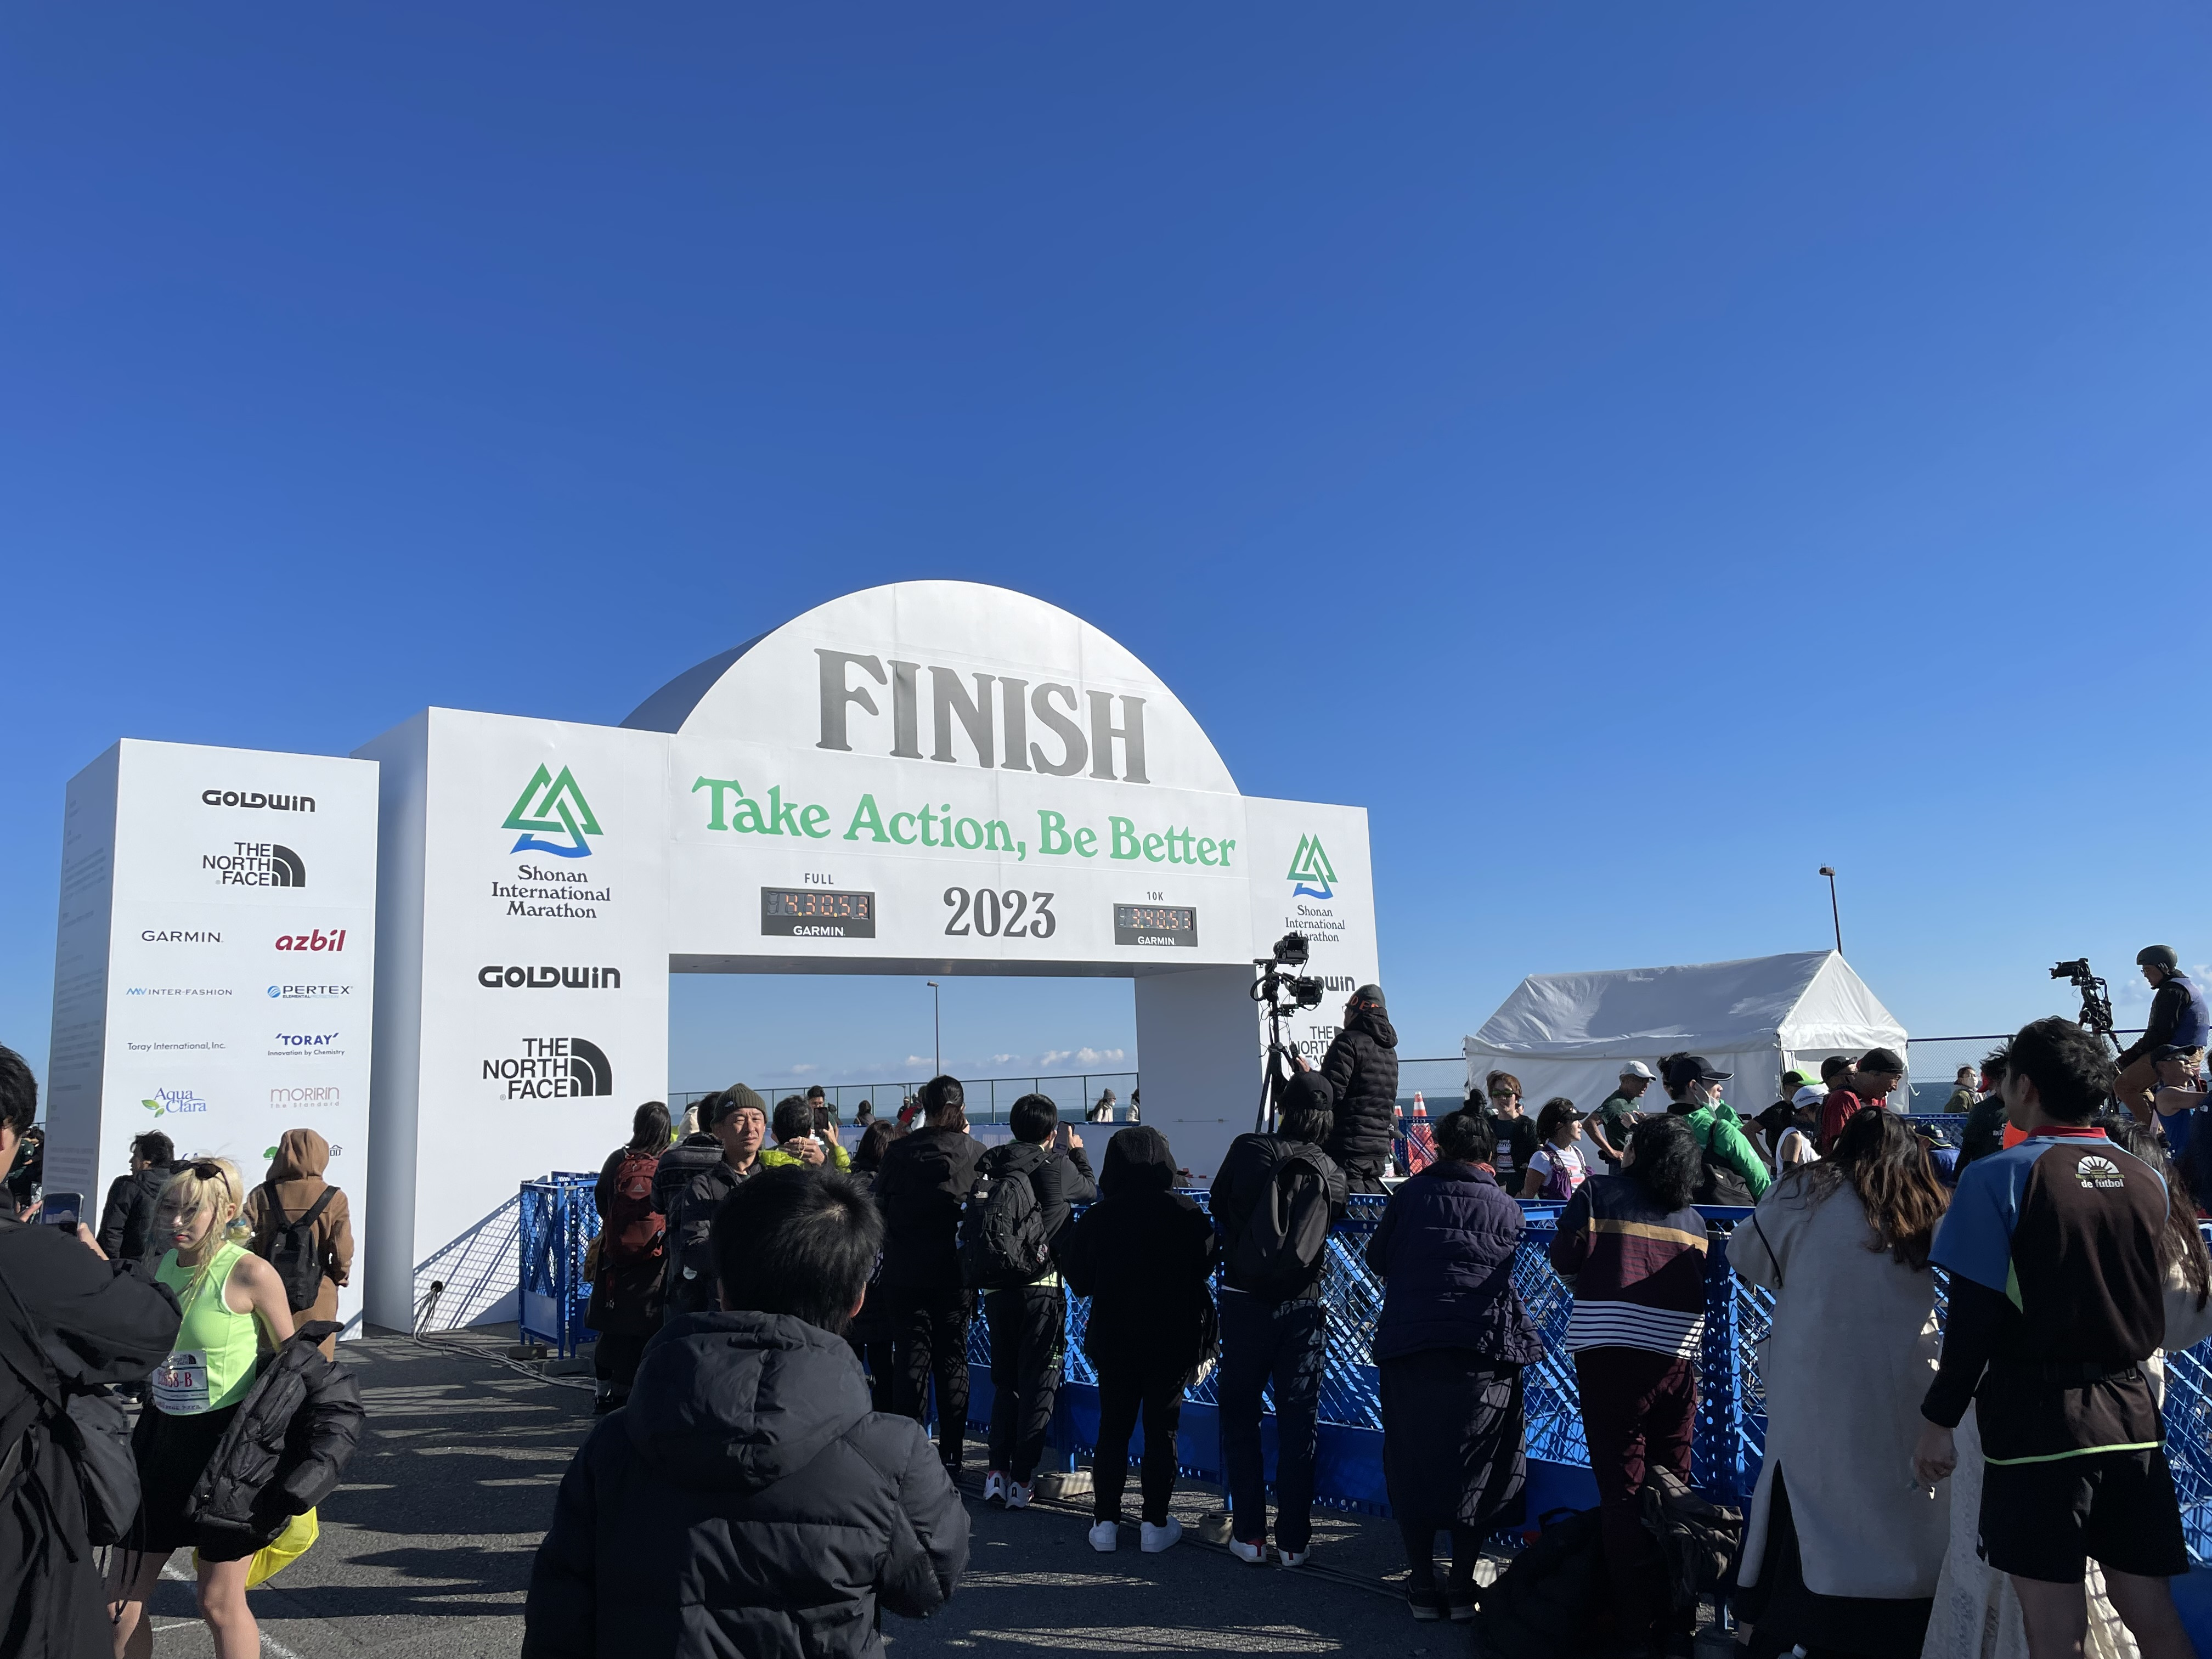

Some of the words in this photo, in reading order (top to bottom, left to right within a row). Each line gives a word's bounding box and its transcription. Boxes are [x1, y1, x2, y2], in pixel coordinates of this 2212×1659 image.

[814, 648, 1150, 784] FINISH
[692, 776, 830, 838] Take
[843, 793, 1026, 861] Action,
[1039, 809, 1098, 859] Be
[1109, 815, 1235, 867] Better
[234, 842, 271, 857] THE
[203, 855, 270, 871] NORTH
[222, 871, 270, 887] FACE
[518, 865, 589, 883] Shonan
[804, 873, 834, 884] FULL
[492, 882, 611, 901] International
[1147, 891, 1164, 901] 10K
[506, 901, 597, 918] Marathon
[944, 887, 1056, 939] 2023
[1297, 905, 1333, 917] Shonan
[793, 926, 844, 936] GARMIN
[1285, 917, 1345, 930] International
[142, 930, 221, 943] GARMIN
[275, 929, 346, 952] azbil
[1137, 936, 1175, 945] GARMIN
[283, 985, 350, 995] PERTEX
[1310, 1025, 1333, 1040] THE
[128, 1042, 152, 1052] Toray
[522, 1037, 568, 1057] THE
[1297, 1040, 1333, 1054] ORT
[483, 1058, 568, 1080] NORTH
[153, 1087, 193, 1103] Aqua
[508, 1079, 568, 1099] FACE
[166, 1099, 207, 1113] Clara
[2081, 1179, 2093, 1188] de
